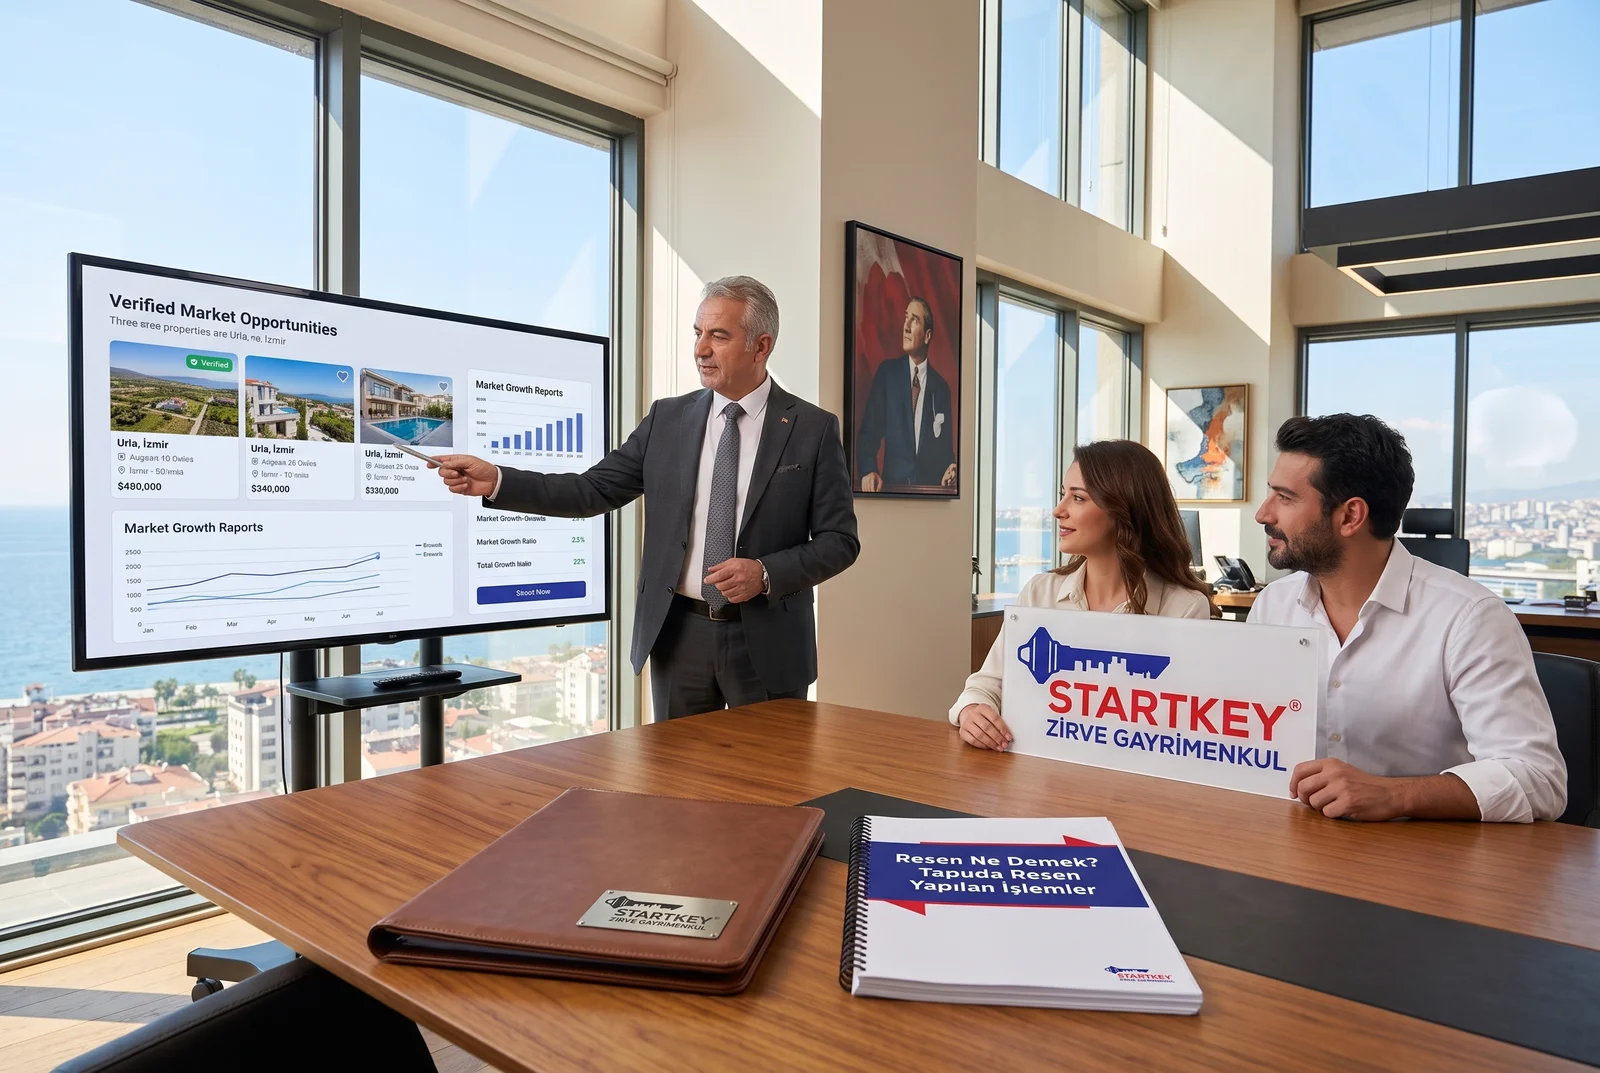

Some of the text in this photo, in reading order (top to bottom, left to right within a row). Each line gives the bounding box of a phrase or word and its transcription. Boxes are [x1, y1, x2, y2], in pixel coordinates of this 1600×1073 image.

[110, 293, 337, 336] Verified Market Opportunities
[110, 316, 138, 327] Three
[164, 324, 210, 336] properties
[214, 330, 227, 338] are
[230, 331, 249, 342] Urla,
[201, 359, 228, 369] Verified
[476, 380, 563, 397] Market Growth Reports
[117, 438, 168, 448] Urla, İzmir
[251, 444, 294, 454] Urla, İzmir
[365, 449, 403, 459] Urla, İzmir
[251, 484, 290, 493] $340,000
[365, 487, 398, 495] $330,000
[124, 522, 263, 534] Market Growth Raports
[1046, 717, 1287, 771] ZİRVE GAYRİMENKUL
[896, 853, 1098, 868] Resen Ne Demek?
[918, 867, 1081, 881] Tapuda Resen
[909, 880, 1096, 895] Yapılan İşlemler
